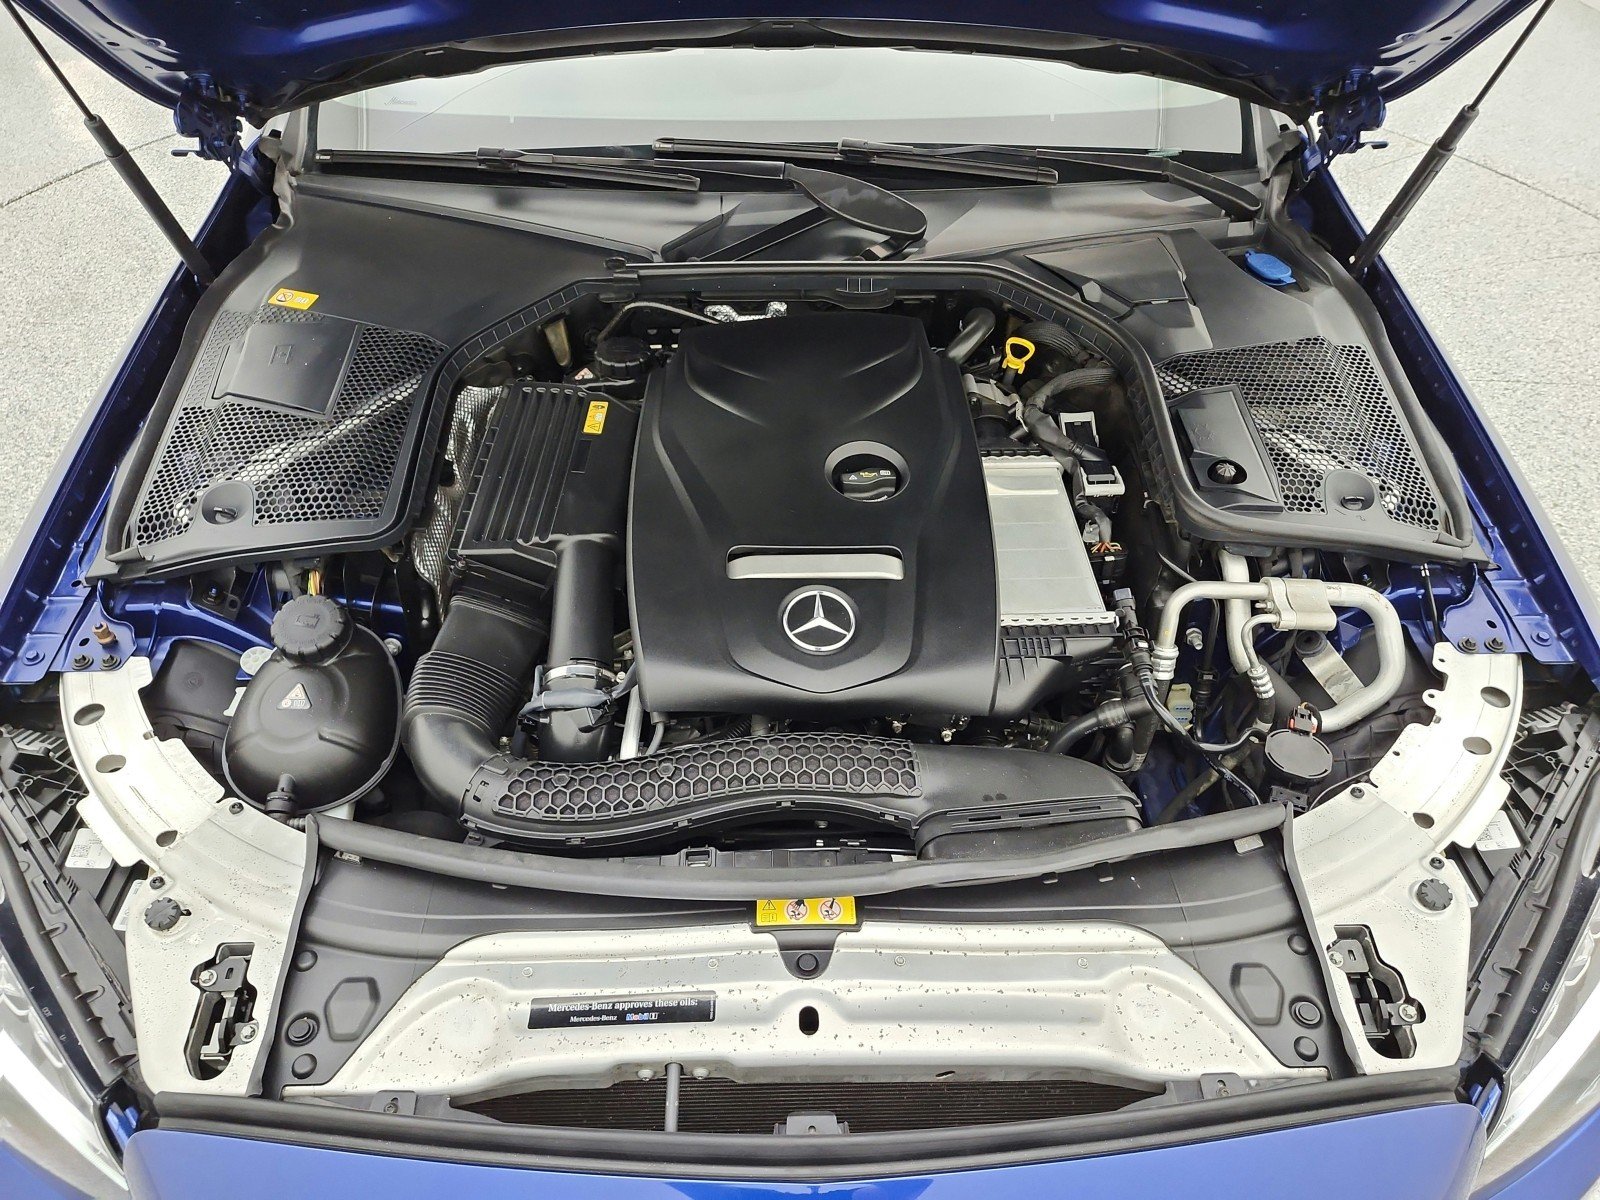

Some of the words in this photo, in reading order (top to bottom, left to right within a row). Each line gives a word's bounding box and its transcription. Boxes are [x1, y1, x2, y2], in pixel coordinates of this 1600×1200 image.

[548, 1002, 612, 1012] Mercedes-Benz
[614, 1001, 653, 1010] approves
[655, 998, 678, 1007] these
[680, 998, 698, 1006] oils:
